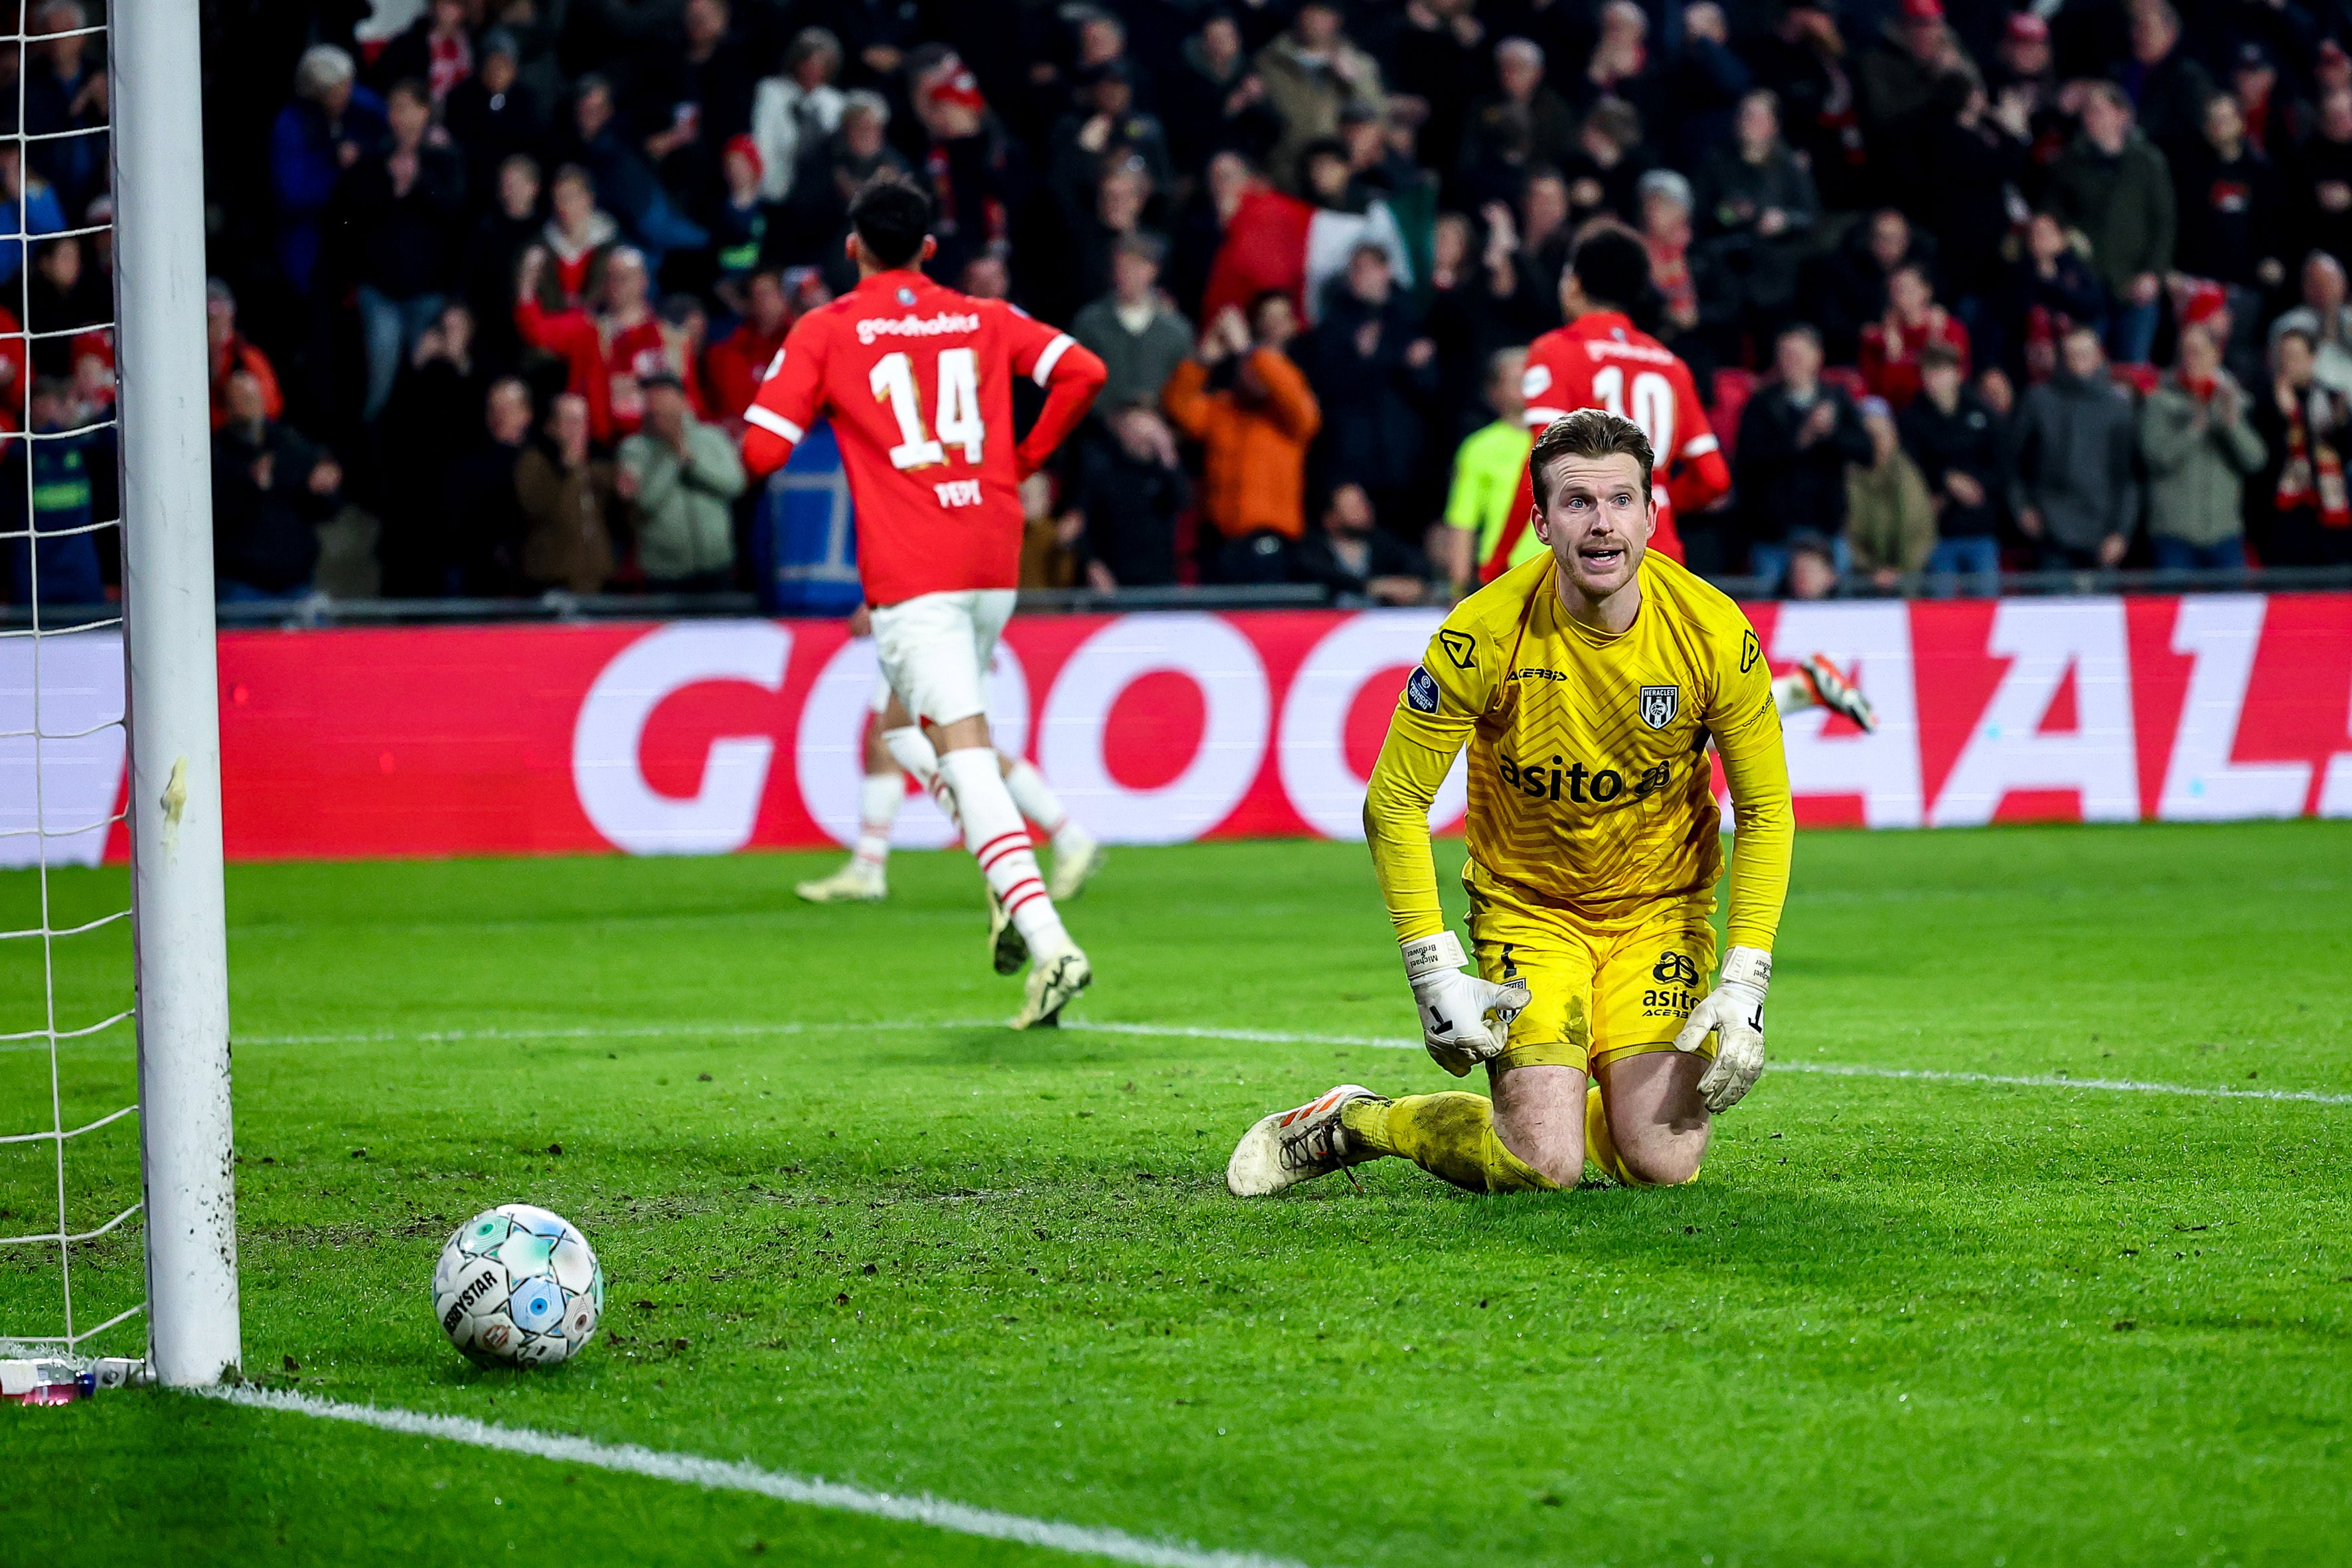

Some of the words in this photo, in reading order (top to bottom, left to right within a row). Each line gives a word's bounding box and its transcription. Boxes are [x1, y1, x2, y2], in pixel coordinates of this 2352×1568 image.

[869, 347, 985, 469] 14
[1593, 364, 1674, 469] 10
[1500, 753, 1622, 803] asito
[1407, 944, 1437, 957] Brouwer
[1410, 955, 1439, 969] Michael
[1500, 943, 1517, 979] 1
[1642, 986, 1701, 1010] asito
